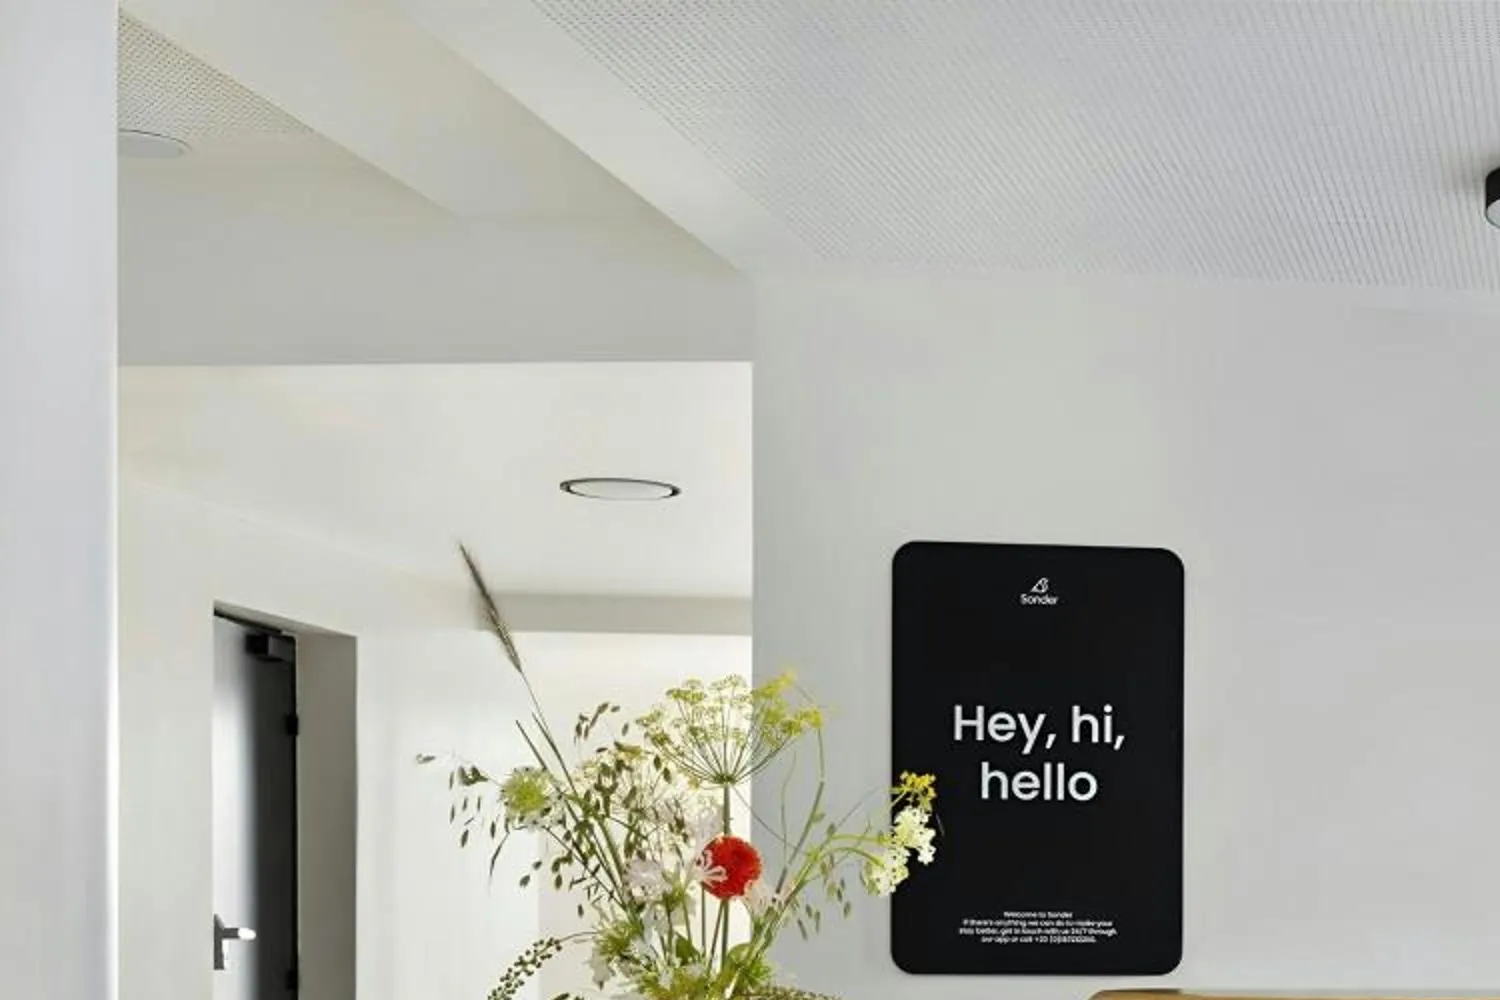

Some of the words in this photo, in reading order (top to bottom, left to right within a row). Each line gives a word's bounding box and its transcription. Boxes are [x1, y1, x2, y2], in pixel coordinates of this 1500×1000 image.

[1021, 592, 1058, 604] Sonder
[955, 705, 1056, 754] Hey,
[1072, 704, 1124, 750] hi,
[982, 762, 1097, 800] hello
[1047, 911, 1073, 919] Sonder
